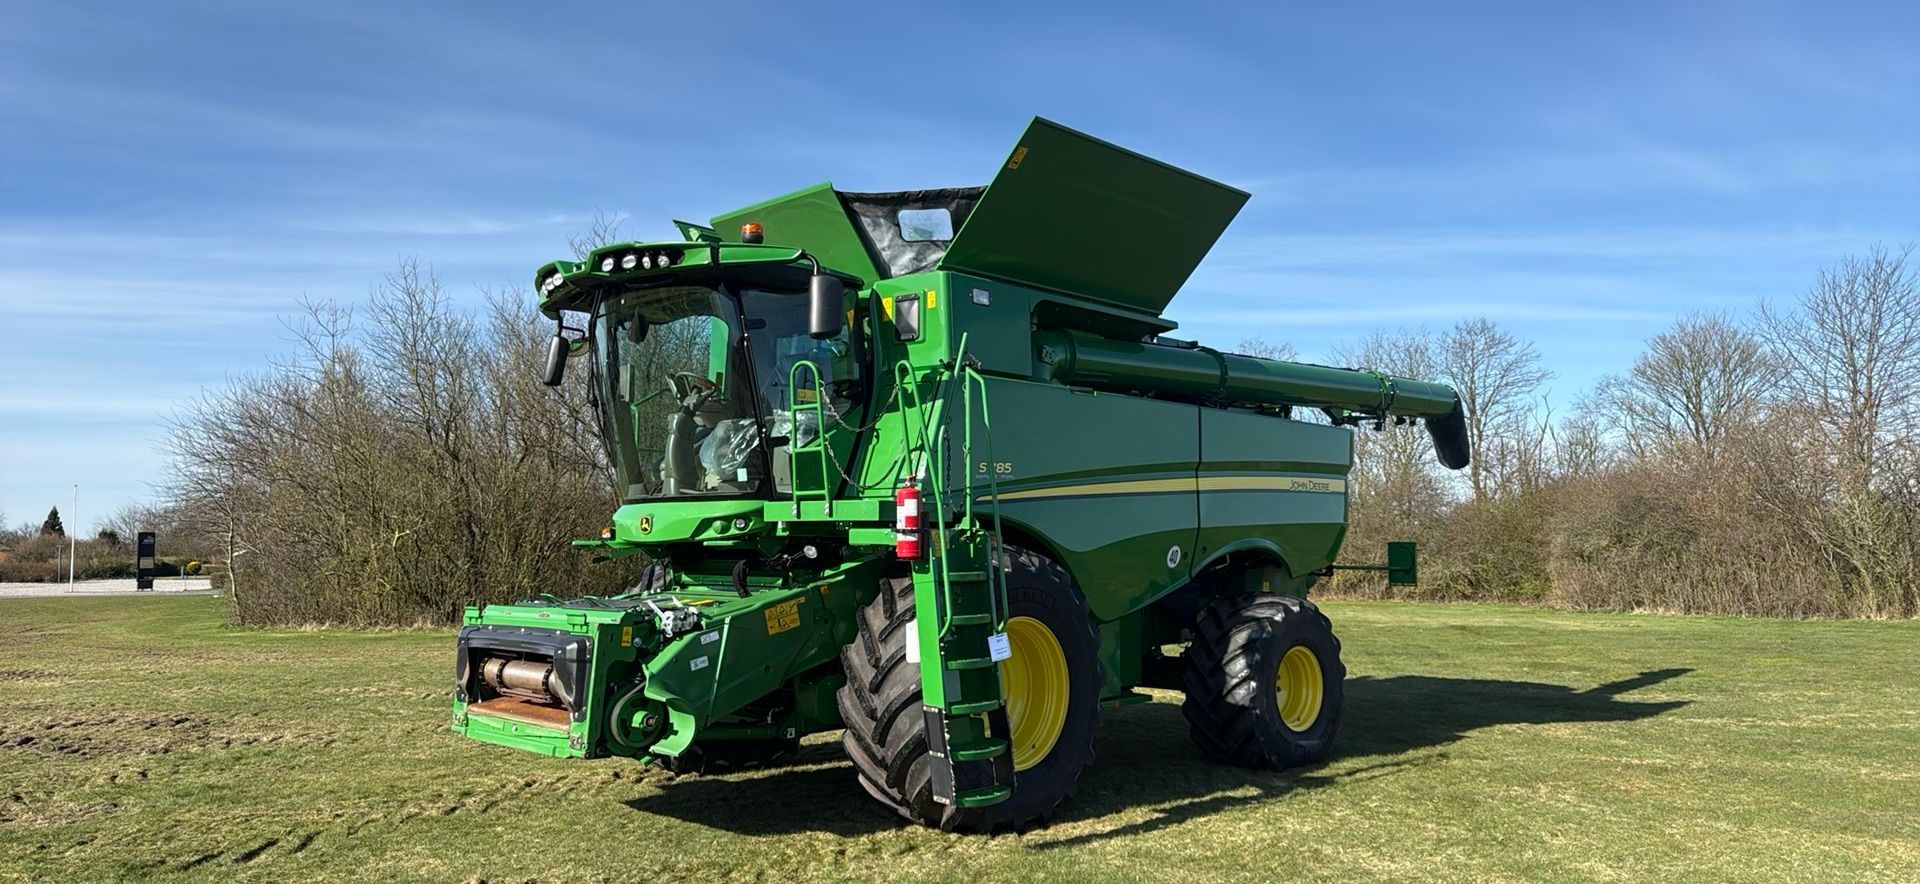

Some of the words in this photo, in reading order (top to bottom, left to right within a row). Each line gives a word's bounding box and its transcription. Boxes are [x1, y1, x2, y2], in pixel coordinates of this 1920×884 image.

[978, 462, 1012, 474] S85
[1289, 479, 1308, 490] JOHN
[1308, 480, 1330, 491] DEERE
[1169, 549, 1179, 565] 40
